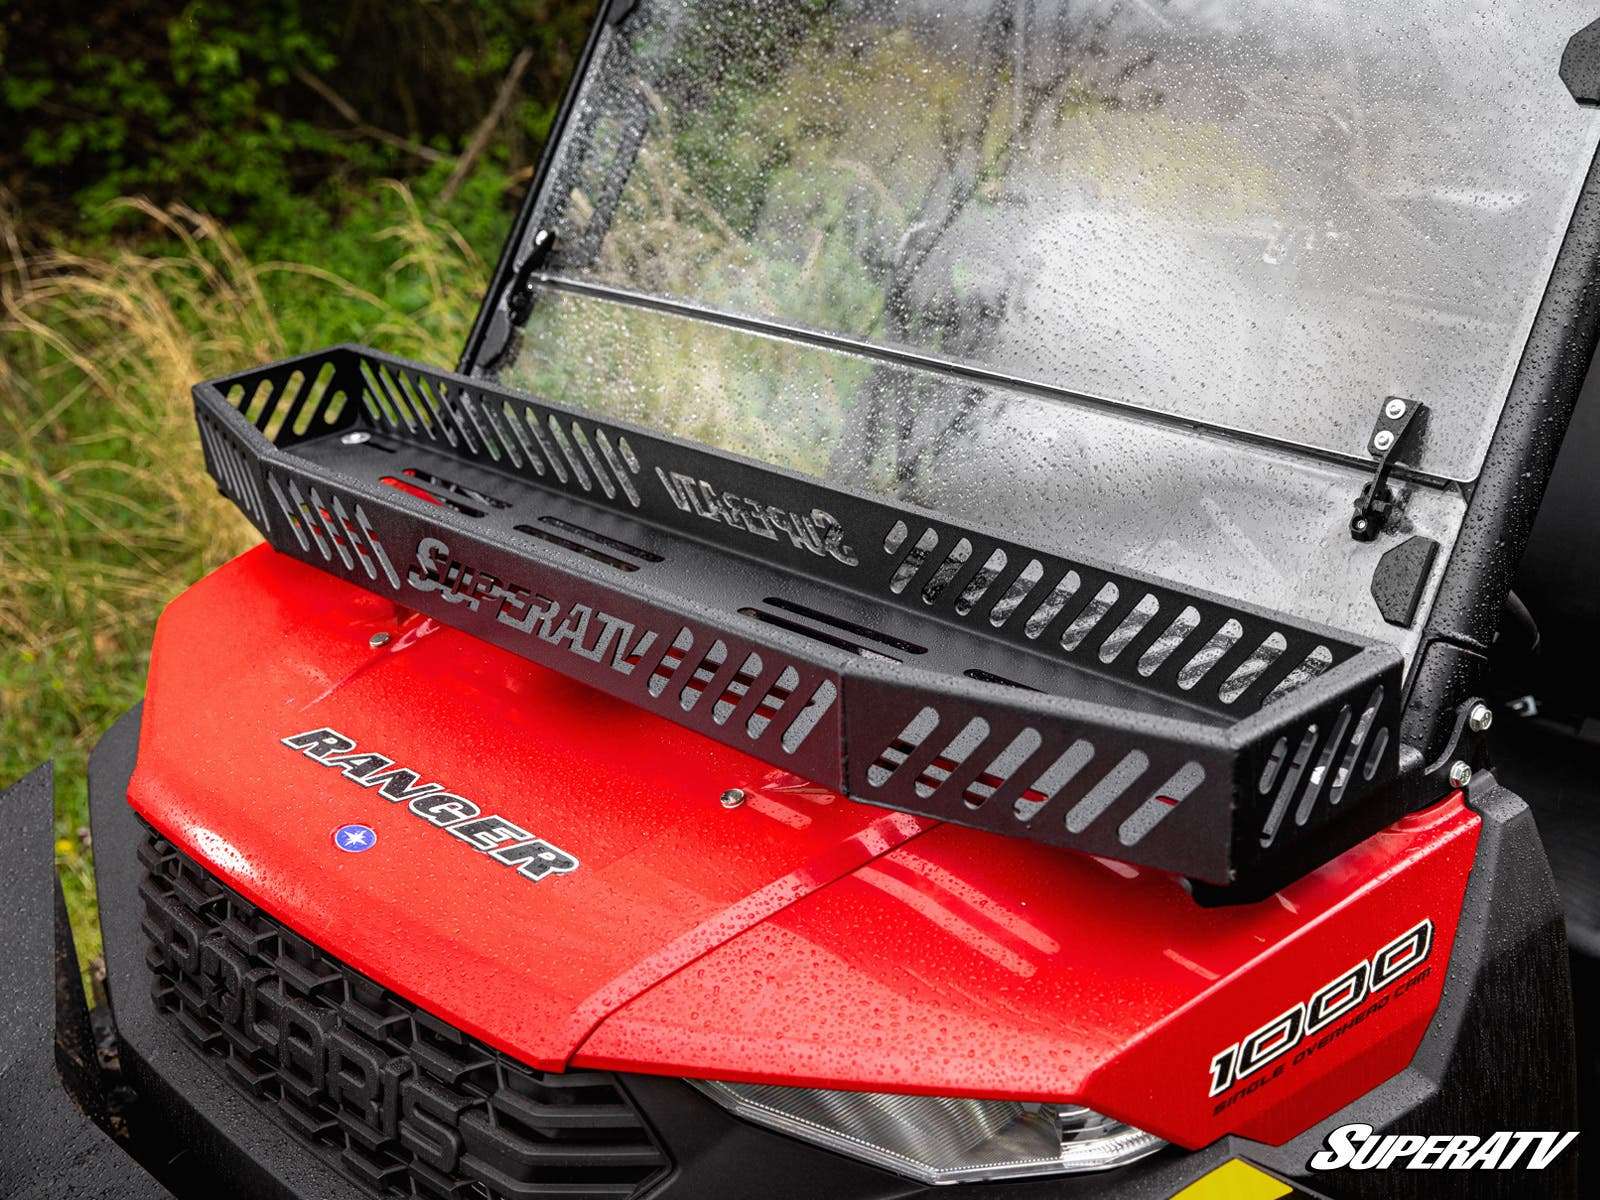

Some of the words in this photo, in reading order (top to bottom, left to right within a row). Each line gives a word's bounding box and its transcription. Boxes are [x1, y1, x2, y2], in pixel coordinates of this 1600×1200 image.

[408, 537, 659, 676] SUPERATV
[281, 727, 581, 883] RANGER
[149, 898, 463, 1174] POLARIS
[1209, 918, 1434, 1098] 1000
[1213, 1064, 1284, 1116] SINGLE
[1292, 993, 1391, 1066] OVERHEAD
[1392, 966, 1432, 998] CAM
